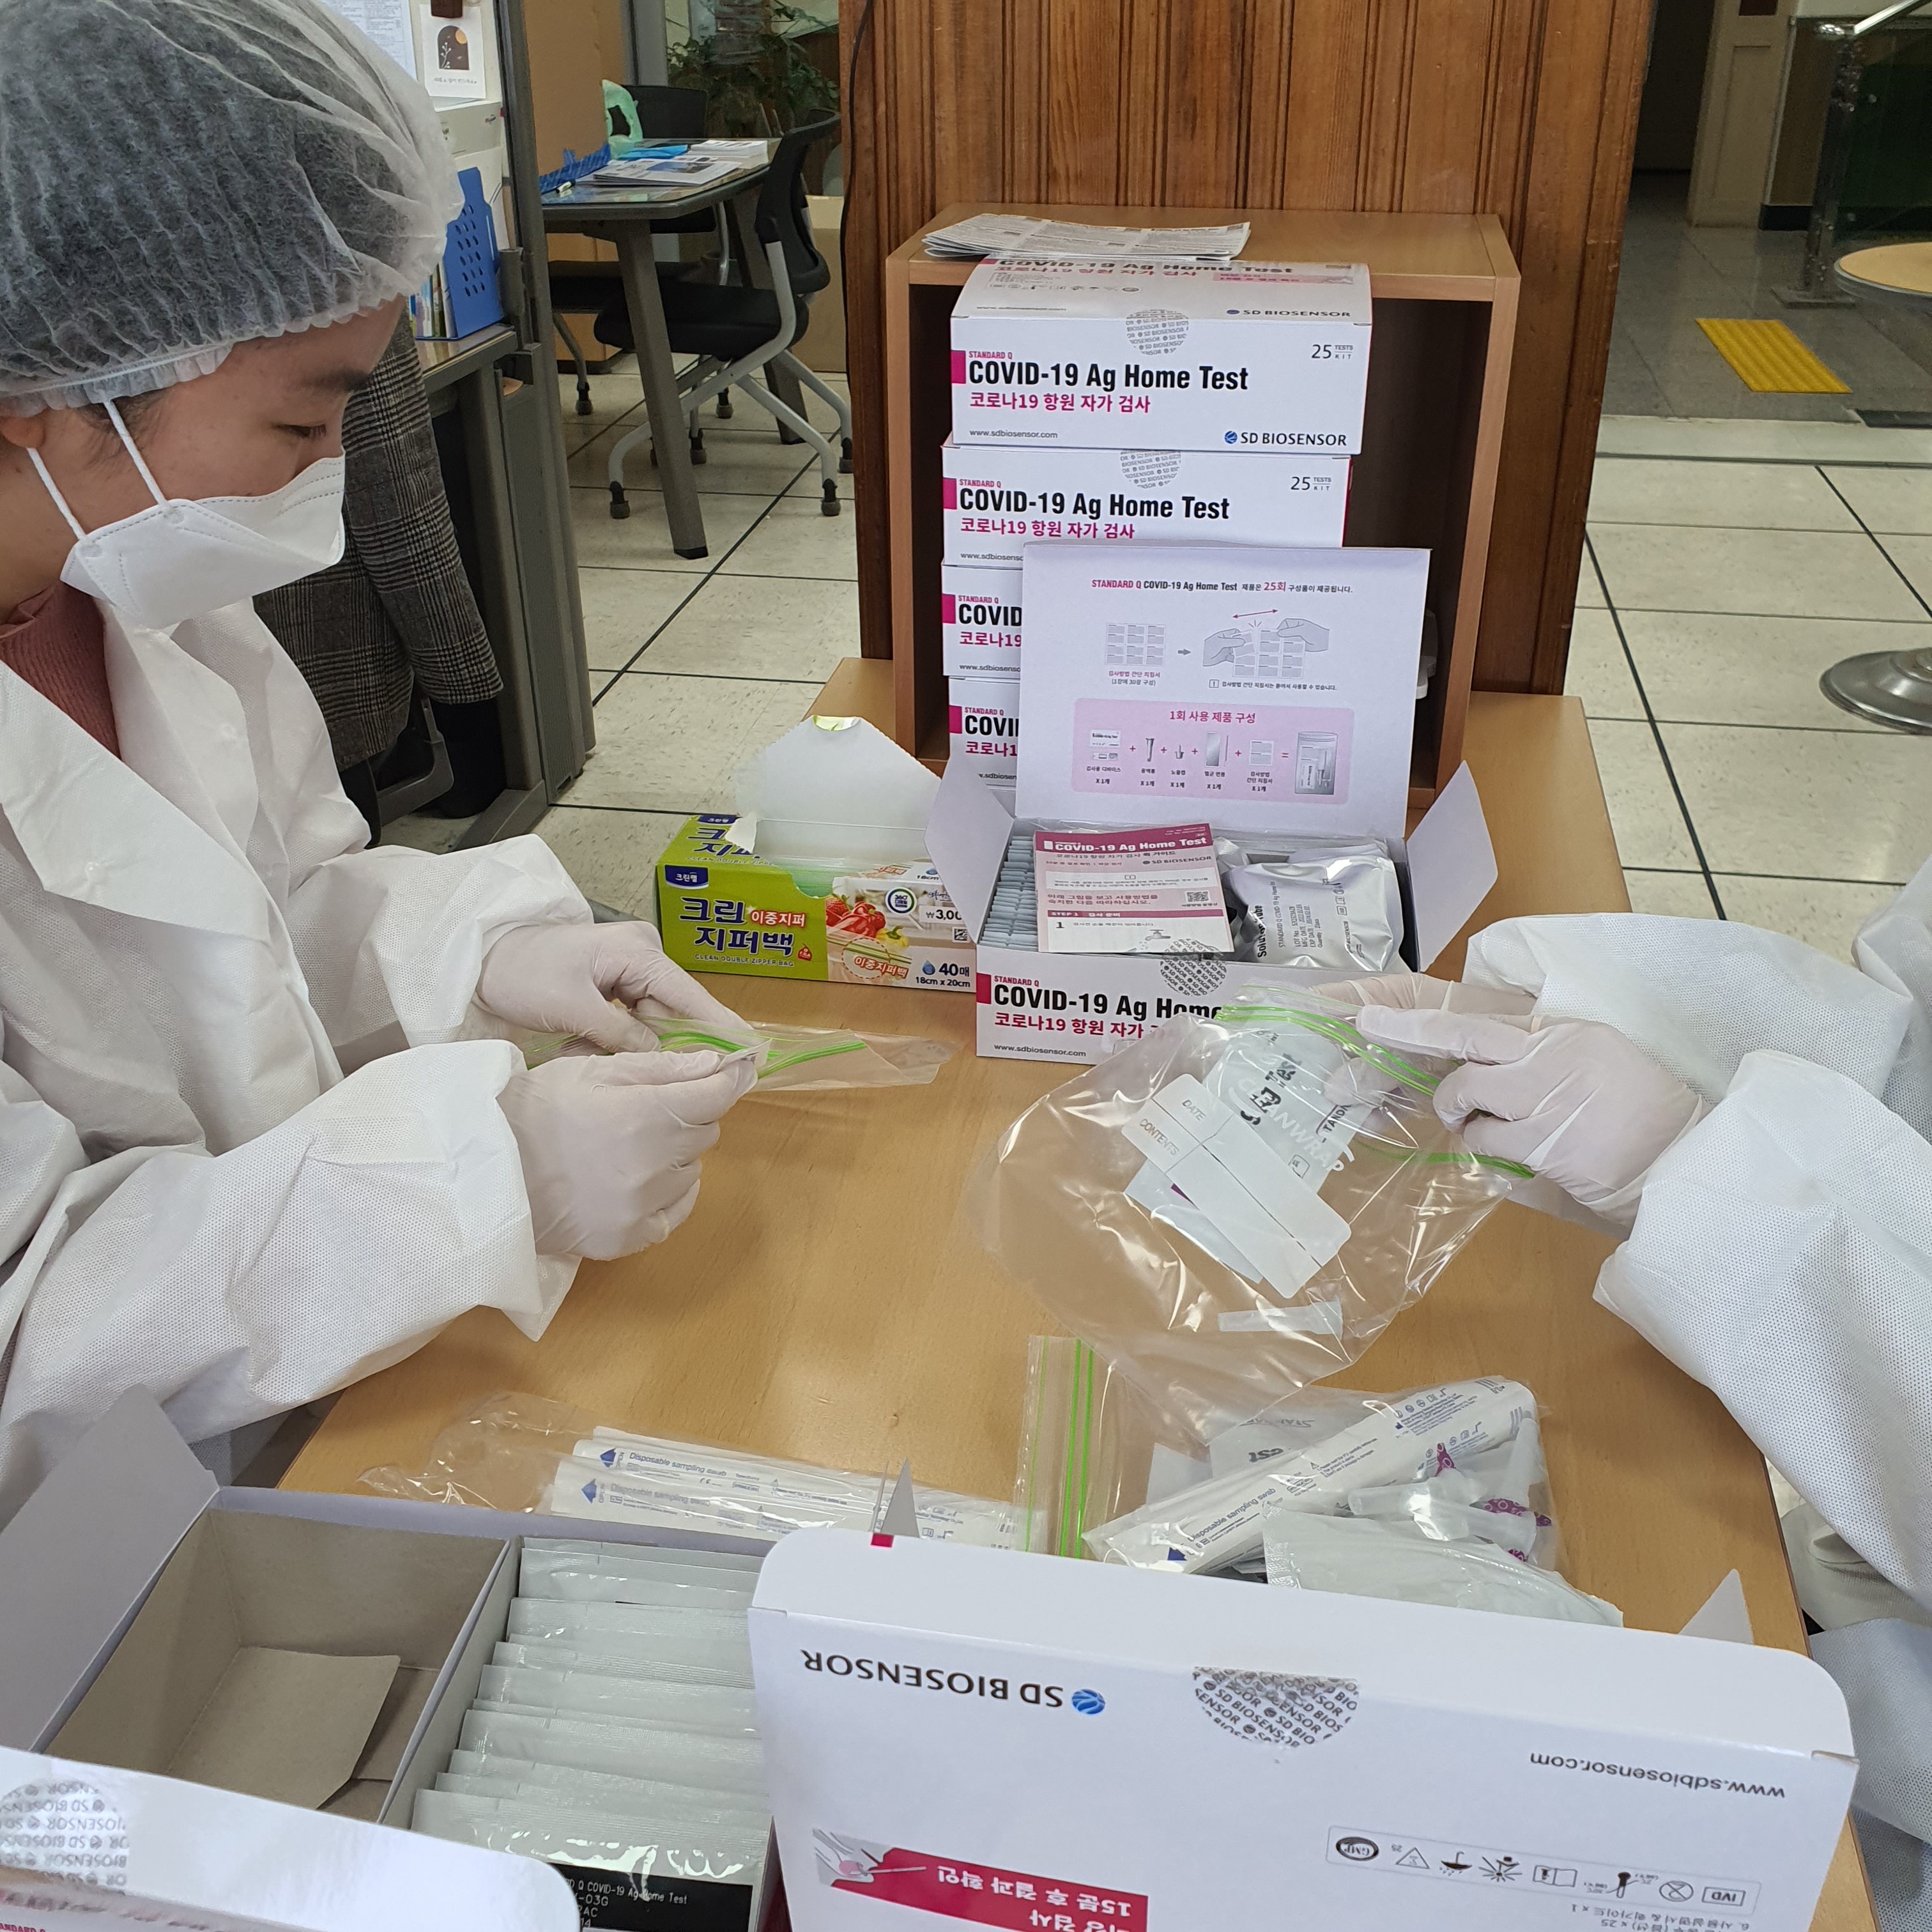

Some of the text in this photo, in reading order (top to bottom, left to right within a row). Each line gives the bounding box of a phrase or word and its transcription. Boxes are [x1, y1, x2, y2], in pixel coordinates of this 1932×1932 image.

[969, 351, 1013, 360] STANDARD Q
[1311, 344, 1332, 358] 25
[969, 360, 1248, 392] COVID-19 Ag Home Test
[970, 392, 1151, 413] 코로나19 항원 자가 검사
[969, 429, 1058, 439] www.sdbiosensor.com
[1240, 432, 1347, 447] SD BIOSENSOR
[959, 479, 1001, 489] STANDARD Q
[1291, 477, 1311, 490] 25
[960, 488, 1230, 519] COVID-19 Ag Home Test
[960, 518, 1135, 539] 코로나19 항원 자가 검사
[1092, 579, 1133, 588] STANDARD
[1136, 580, 1141, 589] Q
[1144, 581, 1181, 590] COVID-19
[1183, 582, 1193, 592] Ag
[1196, 582, 1218, 590] Home
[1221, 582, 1238, 591] Test
[1241, 583, 1262, 592] 제품은
[1264, 581, 1286, 592] 25회
[1288, 585, 1315, 593] 구성품이
[958, 595, 992, 603] STANDARD
[960, 631, 1021, 647] 코로나19
[965, 707, 997, 715] STANDARD
[1170, 710, 1256, 724] 1회 사용 제품 구성
[1055, 843, 1116, 852] COVID-19
[1139, 841, 1176, 850] Home
[1179, 837, 1208, 846] Test
[679, 896, 806, 927] 크린 이중지퍼
[694, 926, 794, 957] 지퍼백
[855, 956, 908, 978] 이중지퍼백
[939, 963, 970, 977] 40매
[916, 976, 938, 985] 18cm
[947, 979, 970, 988] 20cm
[994, 975, 1032, 986] STANDARD
[994, 984, 1108, 1015] COVID-19
[1116, 995, 1147, 1021] Ag
[994, 1011, 1144, 1039] 코로나19 항원 자가
[994, 1044, 1087, 1057] www.sdbiosensor.com
[1182, 1099, 1206, 1121] DATE
[1139, 1119, 1179, 1156] CONTENTS
[629, 1452, 670, 1467] Disposable
[671, 1461, 705, 1473] sampling
[1227, 1498, 1259, 1520] sampling
[1257, 1487, 1276, 1500] swab
[801, 1648, 1064, 1709] SD BIOSENSOR
[1529, 1751, 1786, 1798] www.sdbiosensor.com
[578, 1880, 584, 1890] Q
[587, 1882, 625, 1896] COVID-19
[628, 1888, 640, 1901] Ag
[670, 1892, 687, 1905] Test
[937, 1866, 1131, 1917] 15분 후 결과 확인
[1711, 1890, 1737, 1902] IVD
